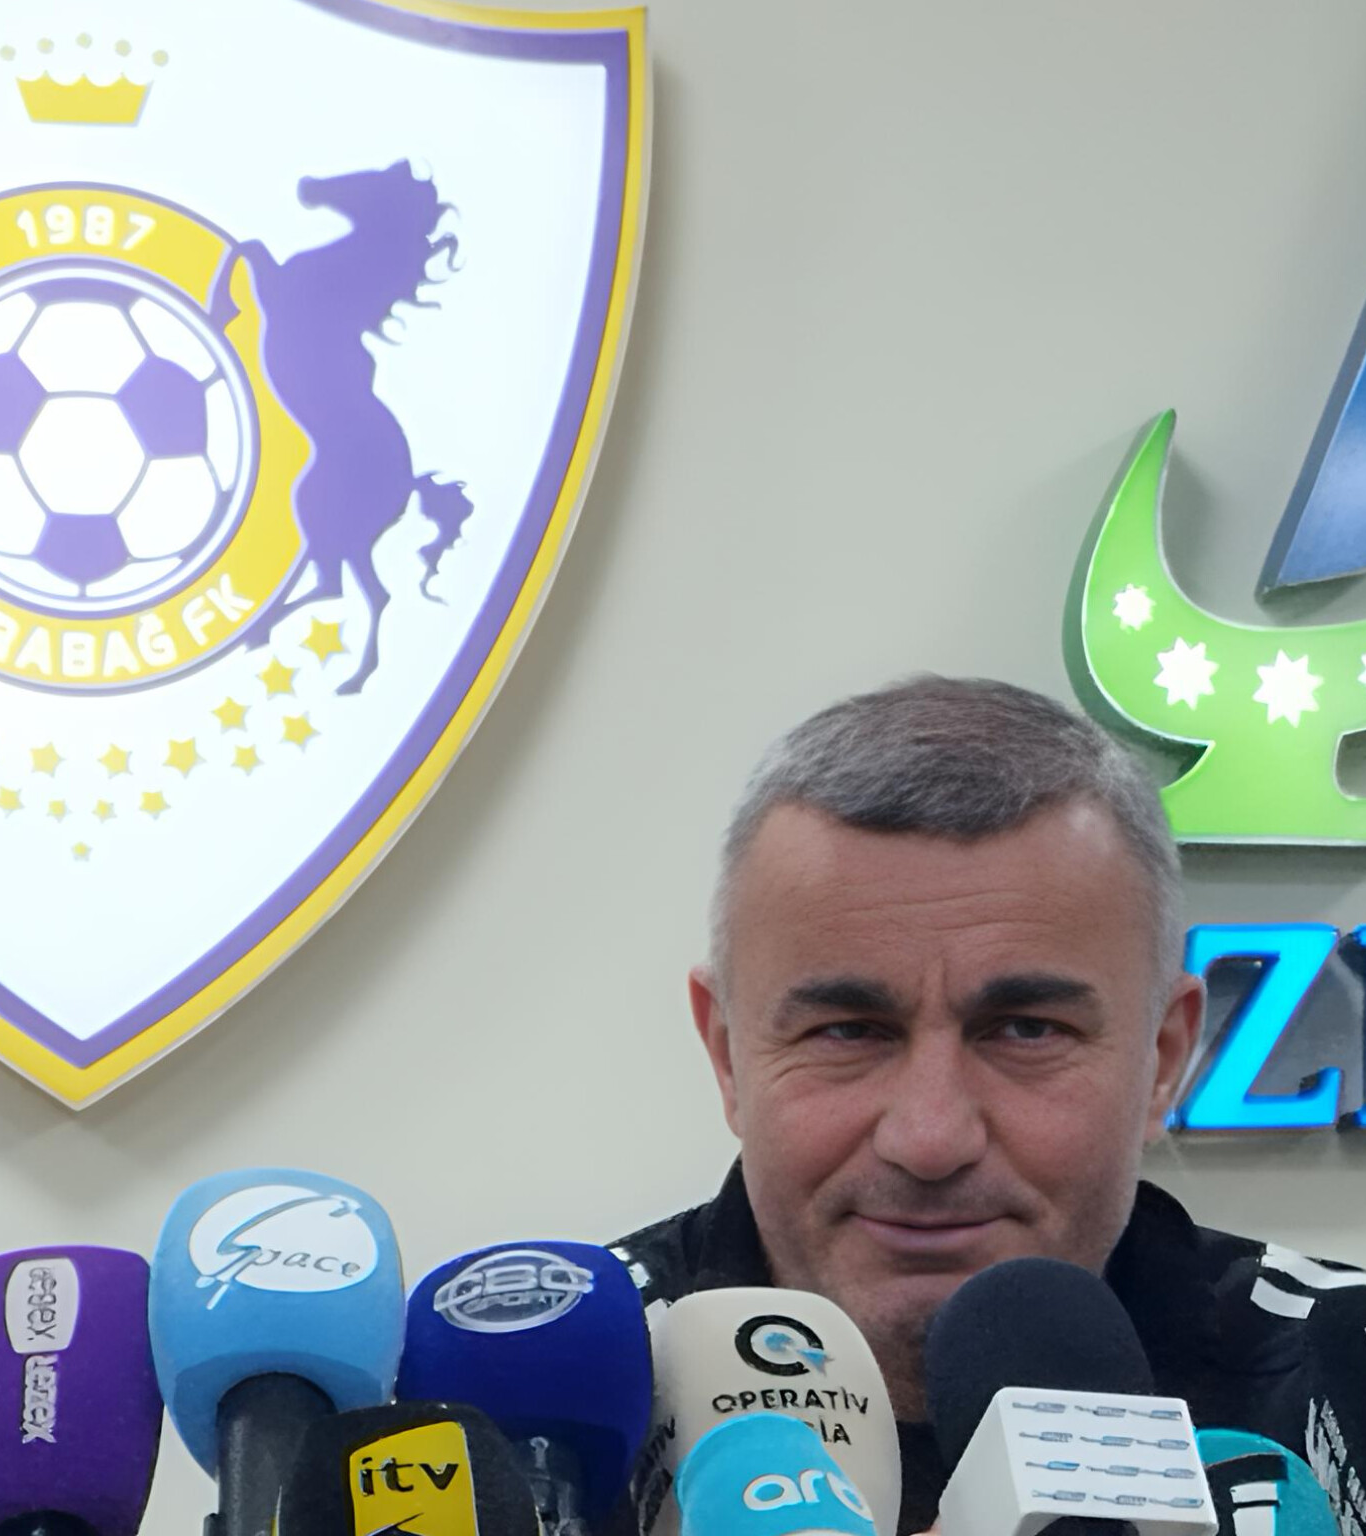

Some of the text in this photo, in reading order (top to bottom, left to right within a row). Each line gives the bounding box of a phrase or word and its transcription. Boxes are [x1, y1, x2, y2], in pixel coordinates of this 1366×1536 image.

[16, 203, 157, 251] 1987
[180, 572, 257, 647] FK
[359, 1456, 460, 1497] itv
